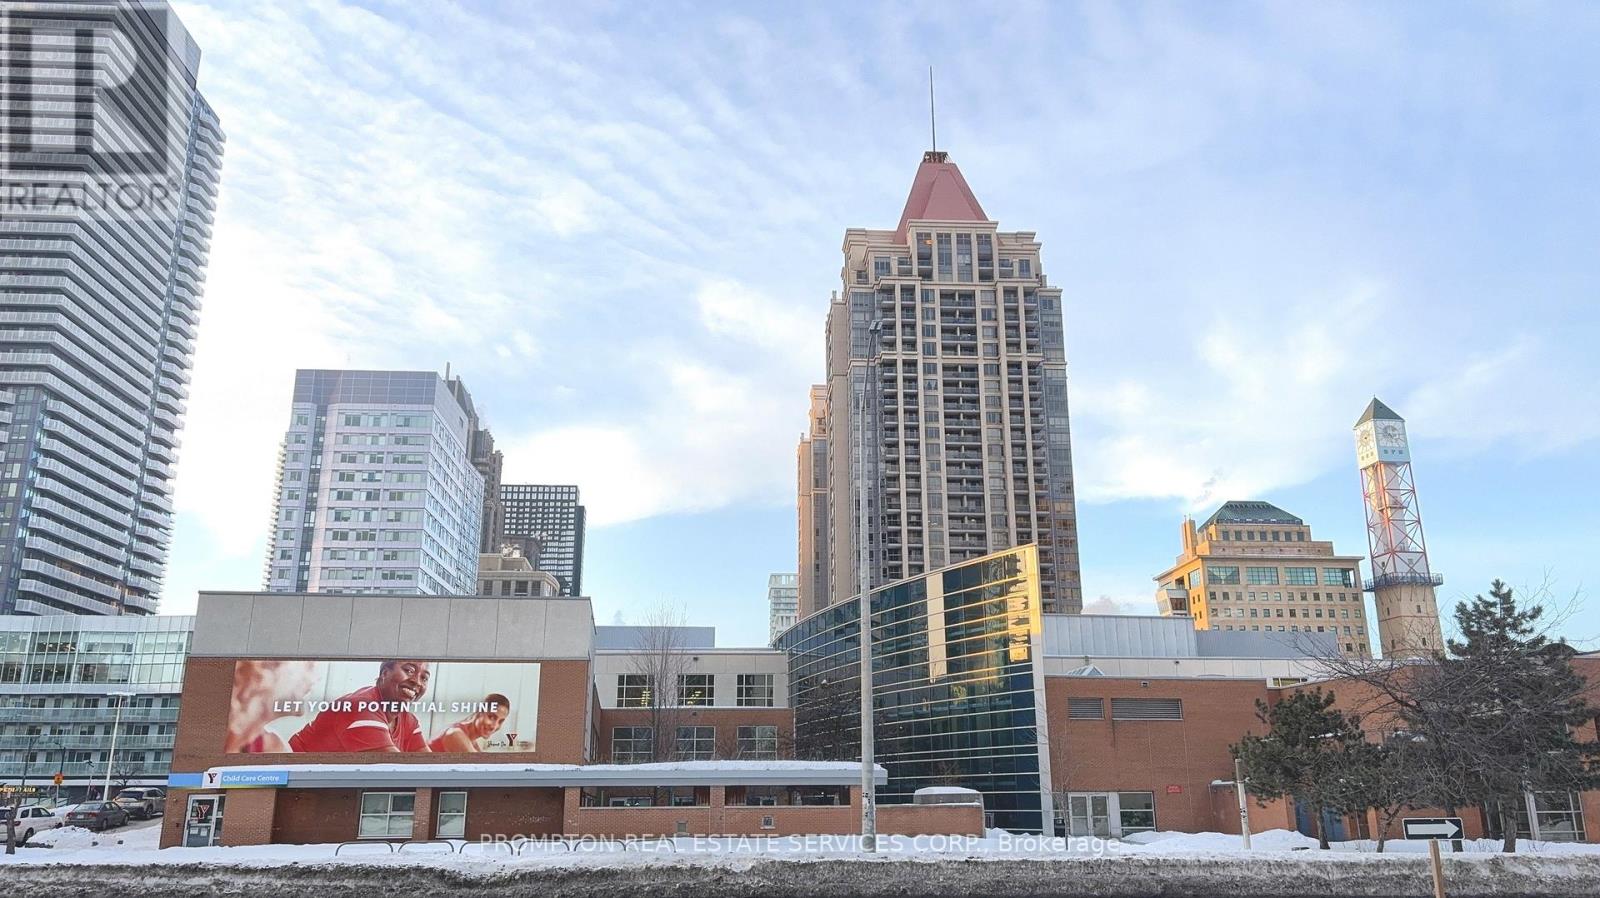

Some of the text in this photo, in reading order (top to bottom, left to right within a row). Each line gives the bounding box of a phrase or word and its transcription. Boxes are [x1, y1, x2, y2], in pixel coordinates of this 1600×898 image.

[273, 701, 499, 713] LET YOUR POTENTIAL SHINE
[257, 774, 280, 782] Centre
